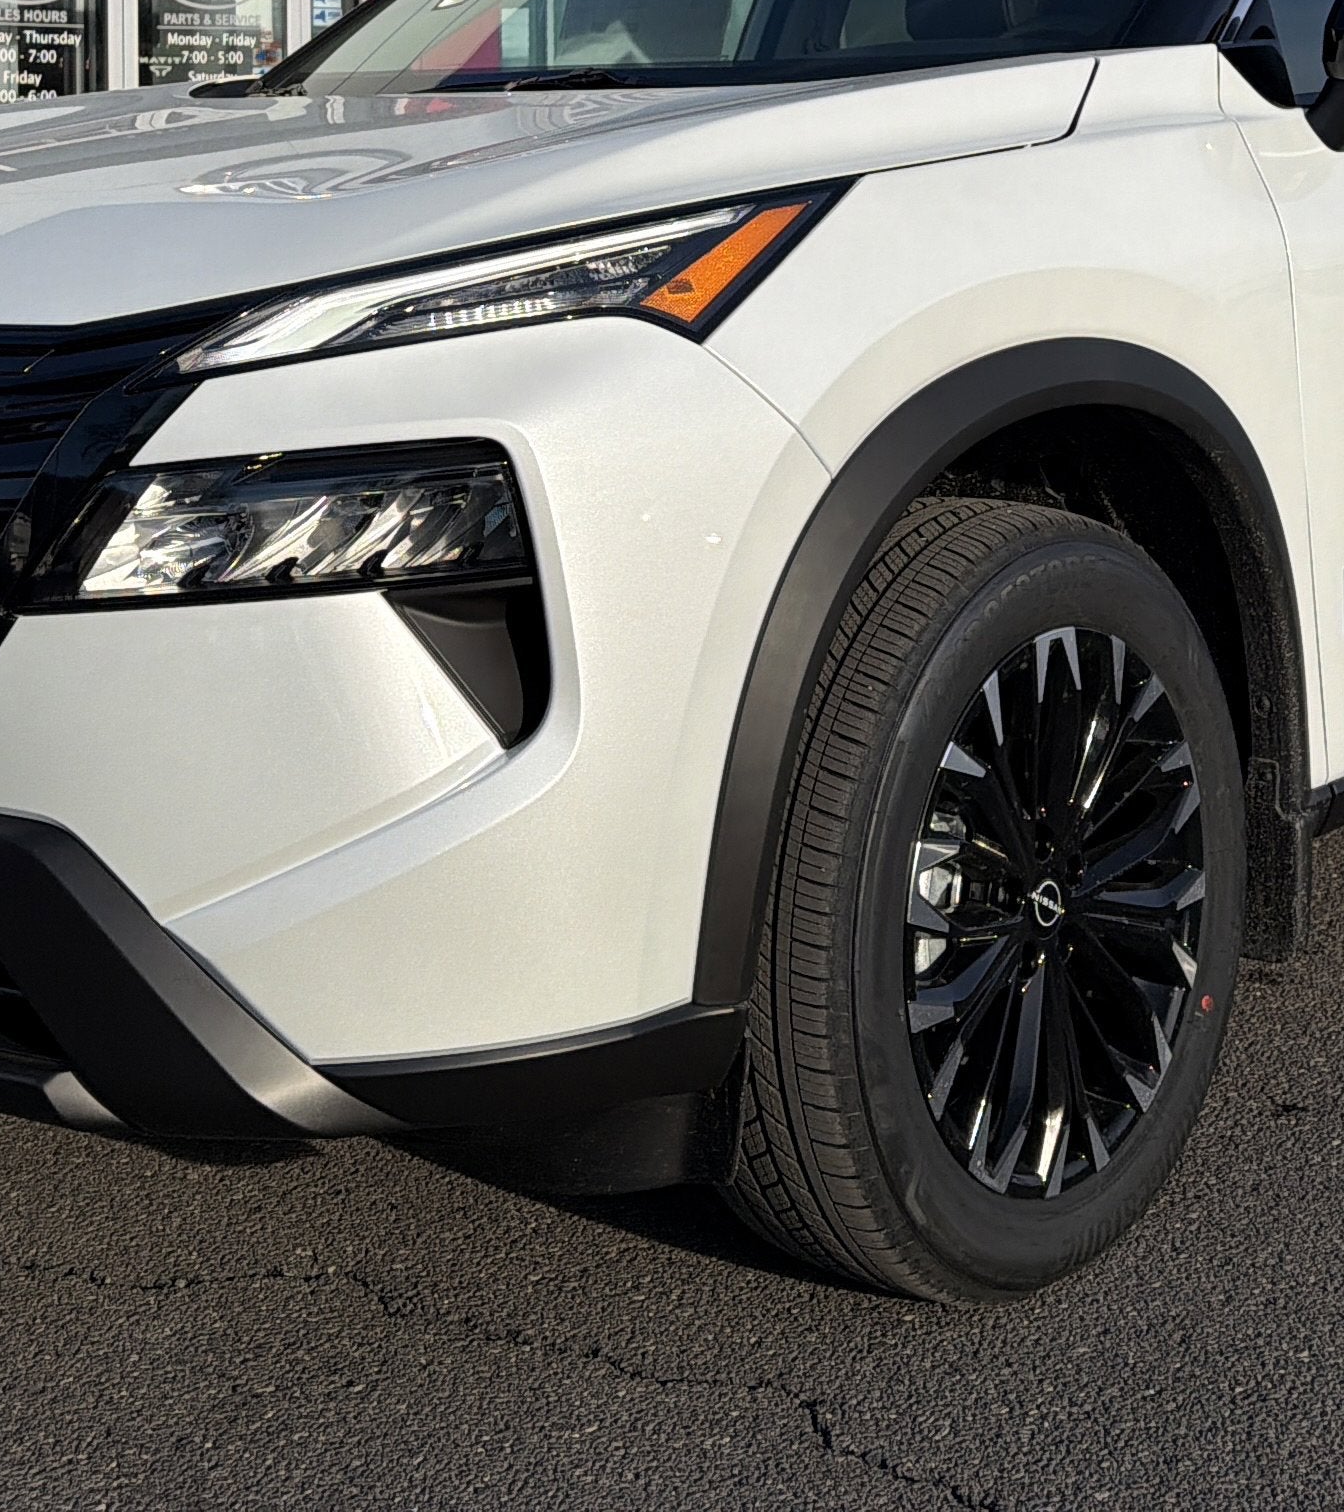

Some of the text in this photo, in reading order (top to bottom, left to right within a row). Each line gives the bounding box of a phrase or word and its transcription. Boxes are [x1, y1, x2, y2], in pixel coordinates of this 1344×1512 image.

[23, 9, 68, 23] HOURS
[163, 12, 262, 27] PARTS & SERVICE
[23, 29, 83, 48] Thursday
[167, 31, 213, 48] Monday
[222, 32, 256, 49] Friday
[28, 49, 57, 64] 7:00
[182, 50, 208, 65] 7:00
[217, 51, 244, 65] 5:00
[2, 70, 43, 88] Friday
